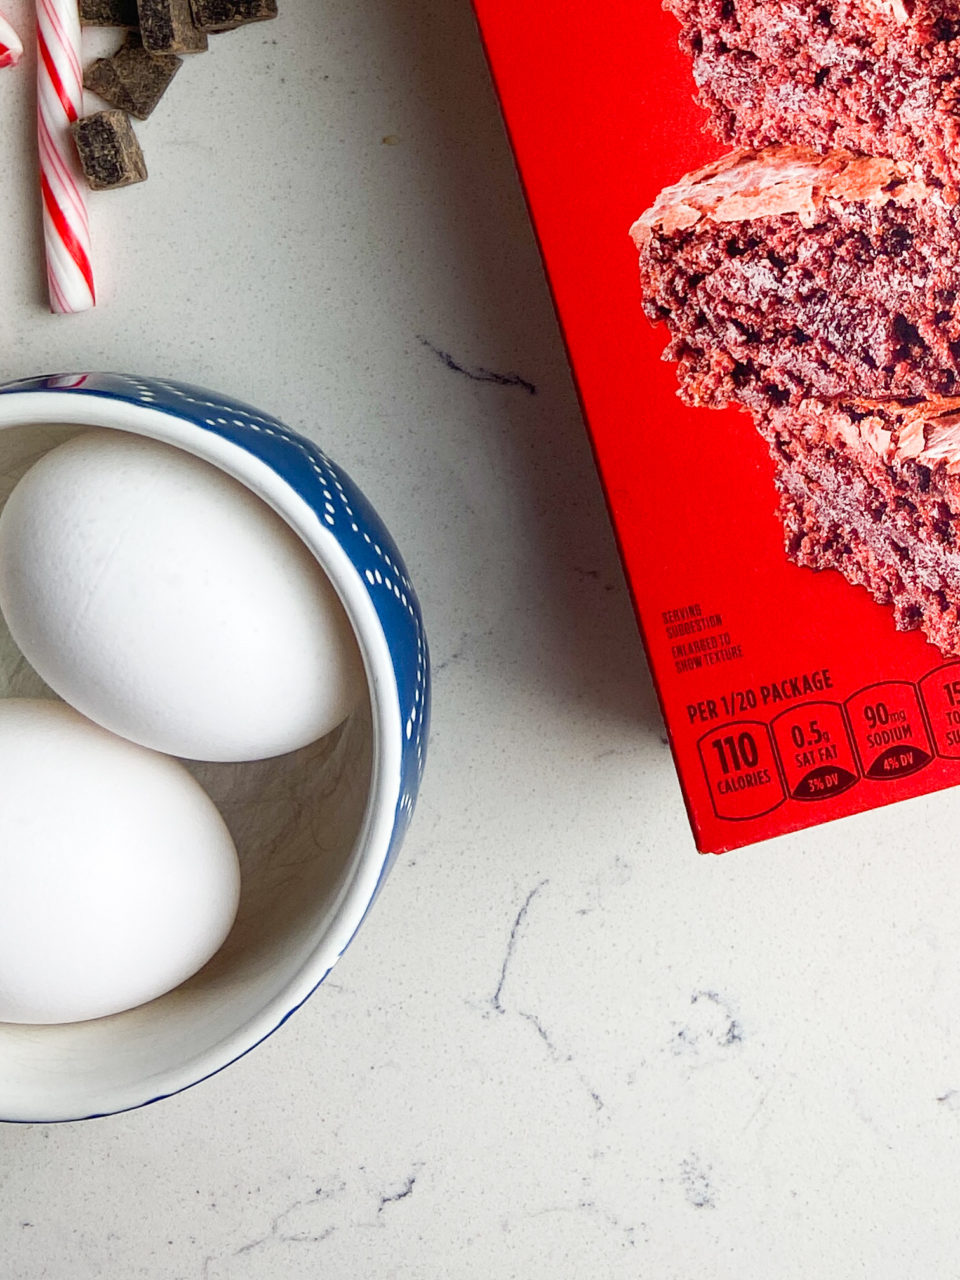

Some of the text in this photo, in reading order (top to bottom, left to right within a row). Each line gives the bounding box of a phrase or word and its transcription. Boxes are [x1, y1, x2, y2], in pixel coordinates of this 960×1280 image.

[662, 603, 702, 624] SERVING
[665, 613, 723, 639] SUGGESTION
[671, 631, 731, 659] ENLARGED TO
[675, 645, 744, 674] SHOW TEXTURE
[686, 669, 834, 724] PER 1/20 PACKAGE
[863, 702, 906, 729] 90mg
[791, 720, 830, 749] 0.5g
[866, 723, 913, 749] SODIUM
[712, 731, 758, 775] 110
[794, 744, 838, 768] SAT FAT
[883, 751, 914, 771] 4% DV
[716, 769, 771, 795] CALORIES
[808, 773, 839, 792] 3% DV
